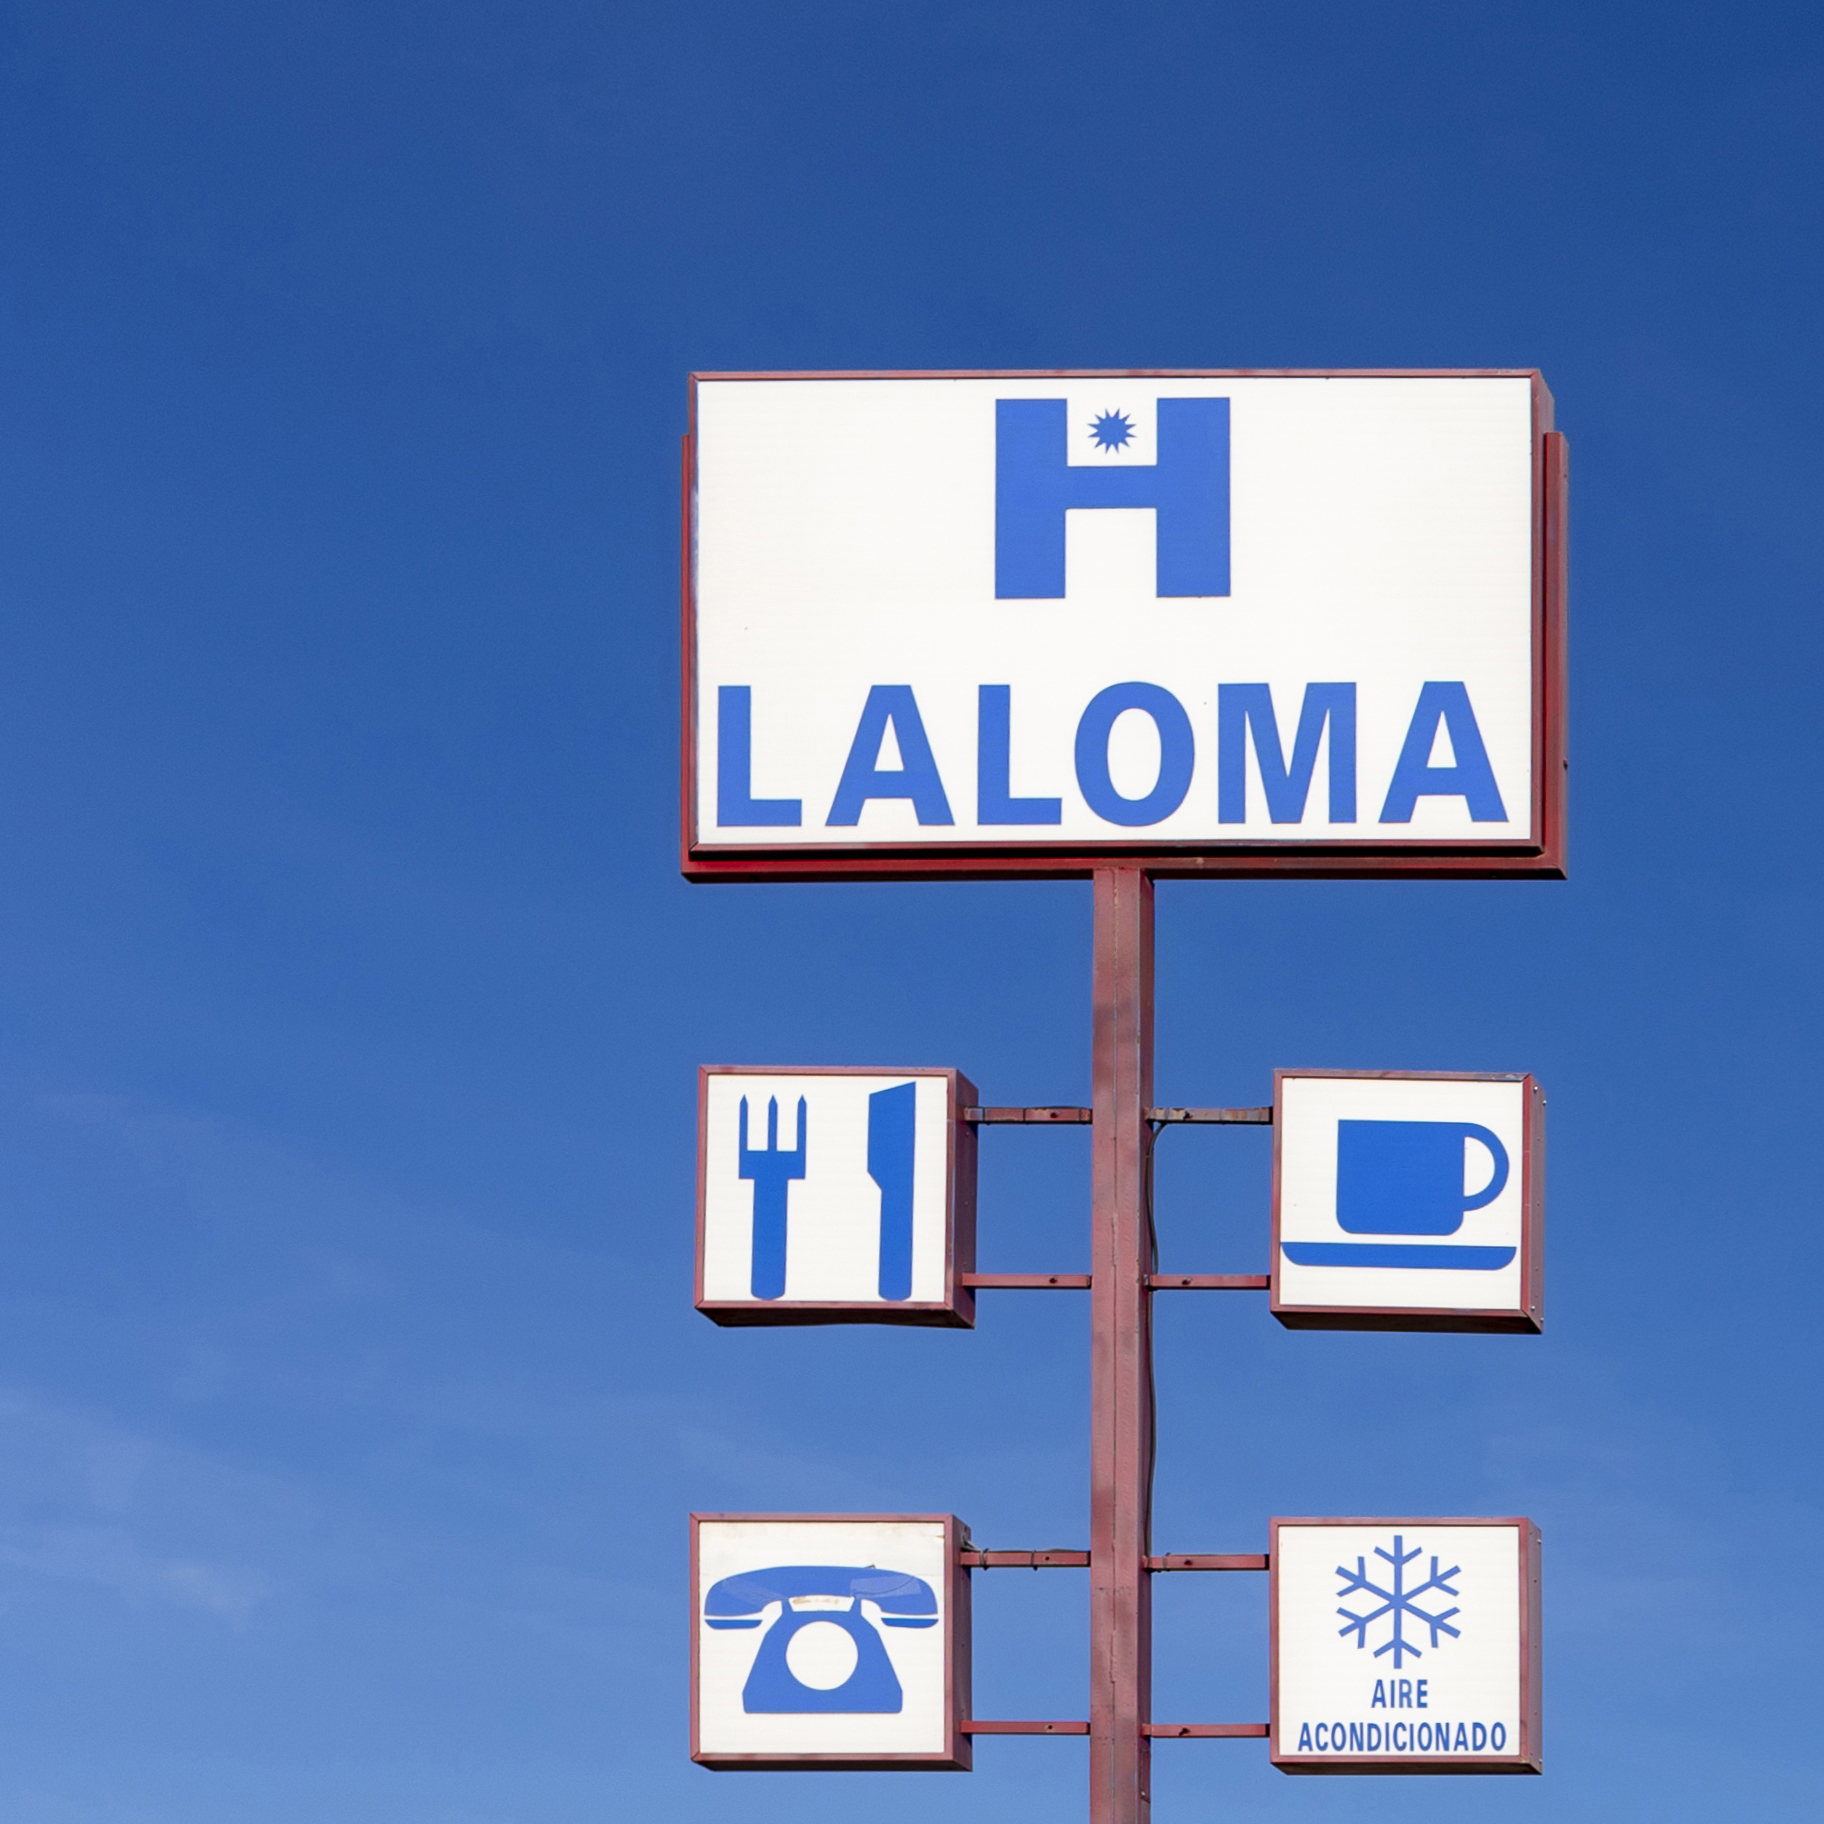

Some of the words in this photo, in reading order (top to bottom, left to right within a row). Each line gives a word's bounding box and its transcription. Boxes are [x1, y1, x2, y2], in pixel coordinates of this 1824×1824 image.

[995, 398, 1231, 599] H
[717, 680, 1508, 827] LALOMA
[1298, 1721, 1507, 1751] ACONDICIONADO
[1371, 1679, 1428, 1708] AIRE
